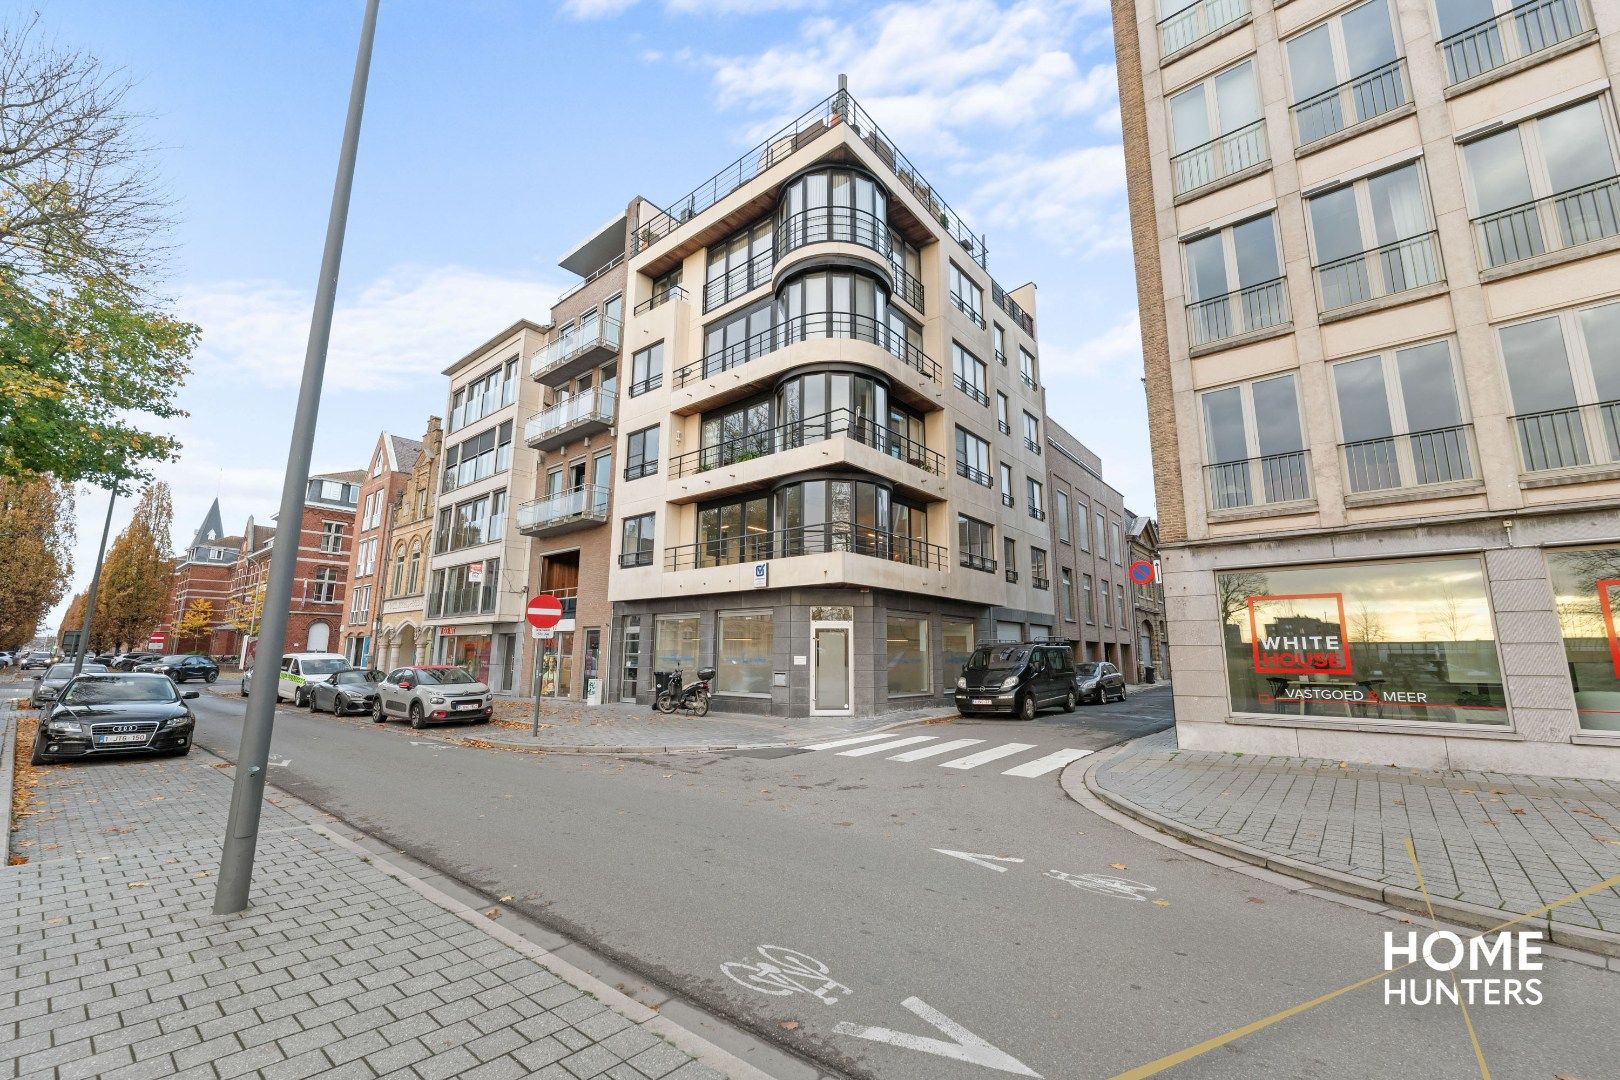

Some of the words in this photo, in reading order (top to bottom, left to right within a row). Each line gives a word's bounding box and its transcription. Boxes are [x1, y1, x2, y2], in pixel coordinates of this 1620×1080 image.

[1260, 635, 1340, 650] WHITE
[1262, 651, 1342, 667] HOUSE
[1285, 688, 1364, 700] VASTGOED
[1383, 691, 1427, 703] MEER
